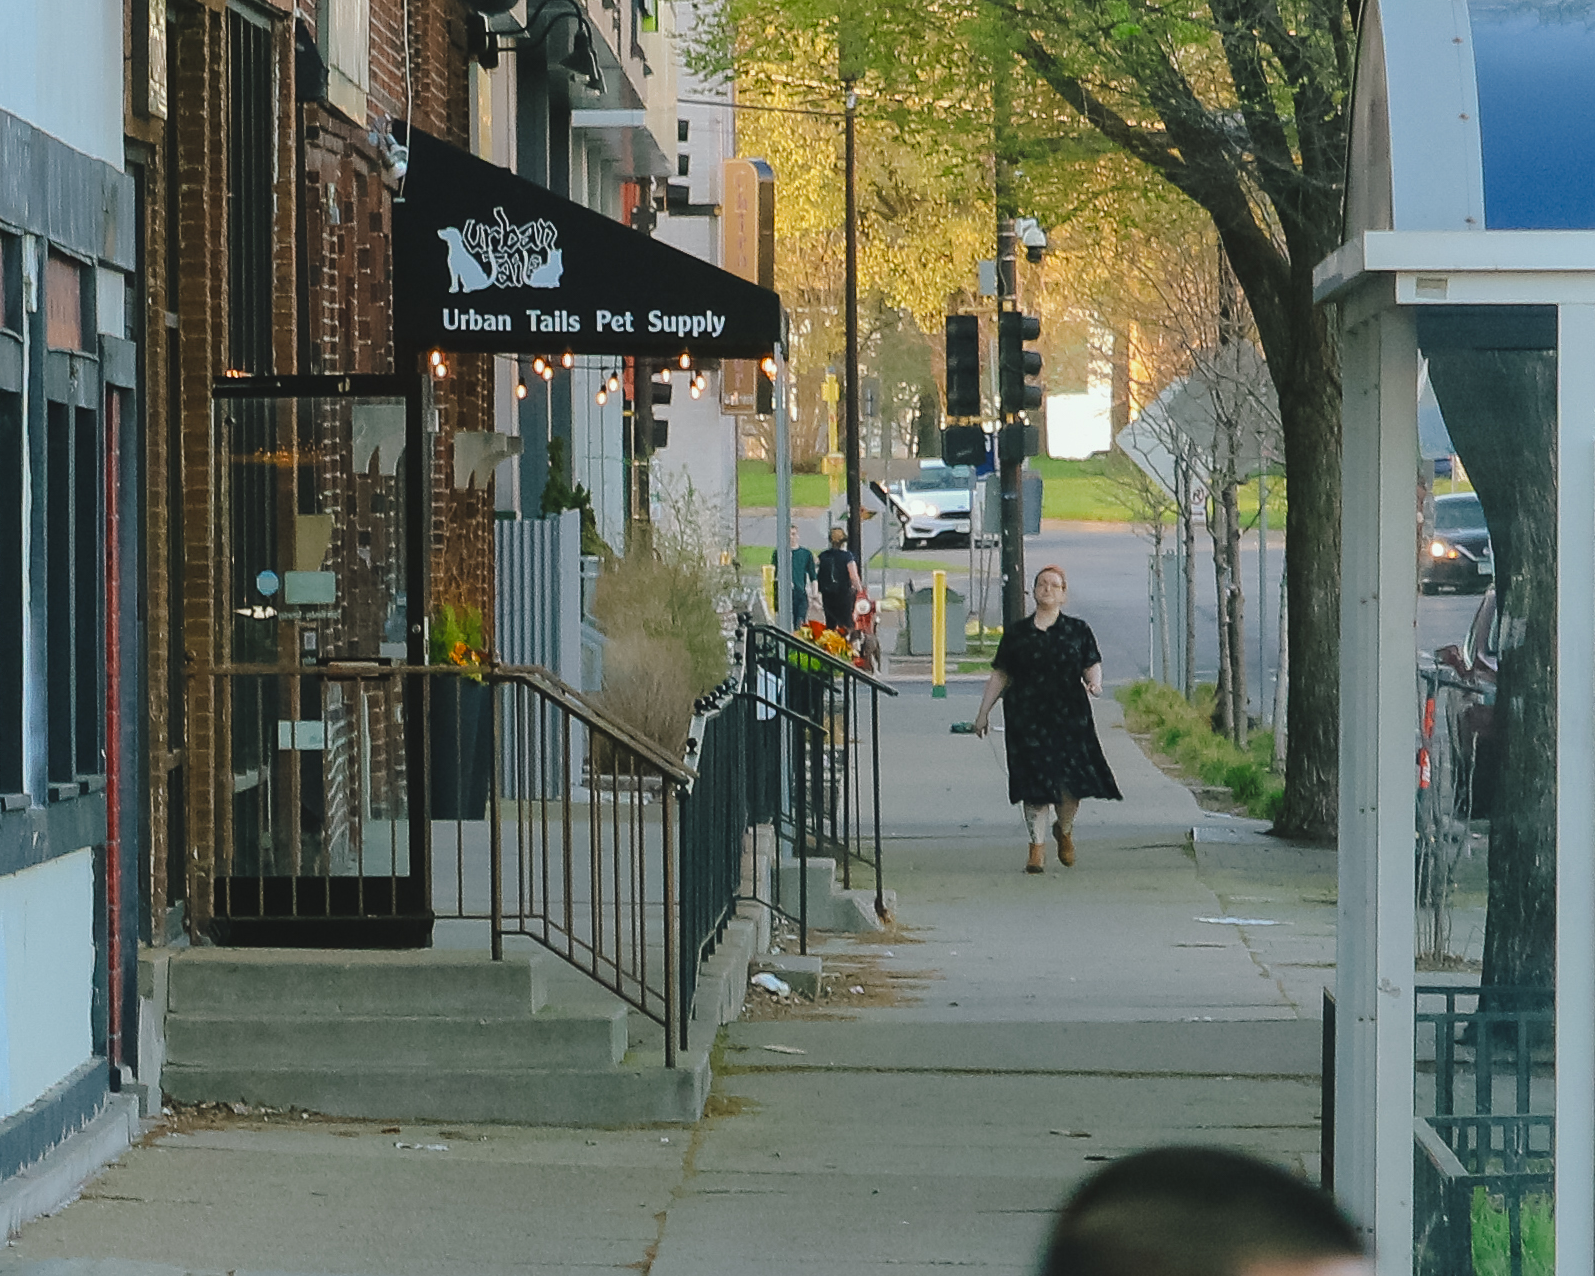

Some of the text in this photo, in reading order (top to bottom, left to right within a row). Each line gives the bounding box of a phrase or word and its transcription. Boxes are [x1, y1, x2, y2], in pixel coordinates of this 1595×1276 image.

[442, 308, 726, 338] Urban Tails Pet Supply
